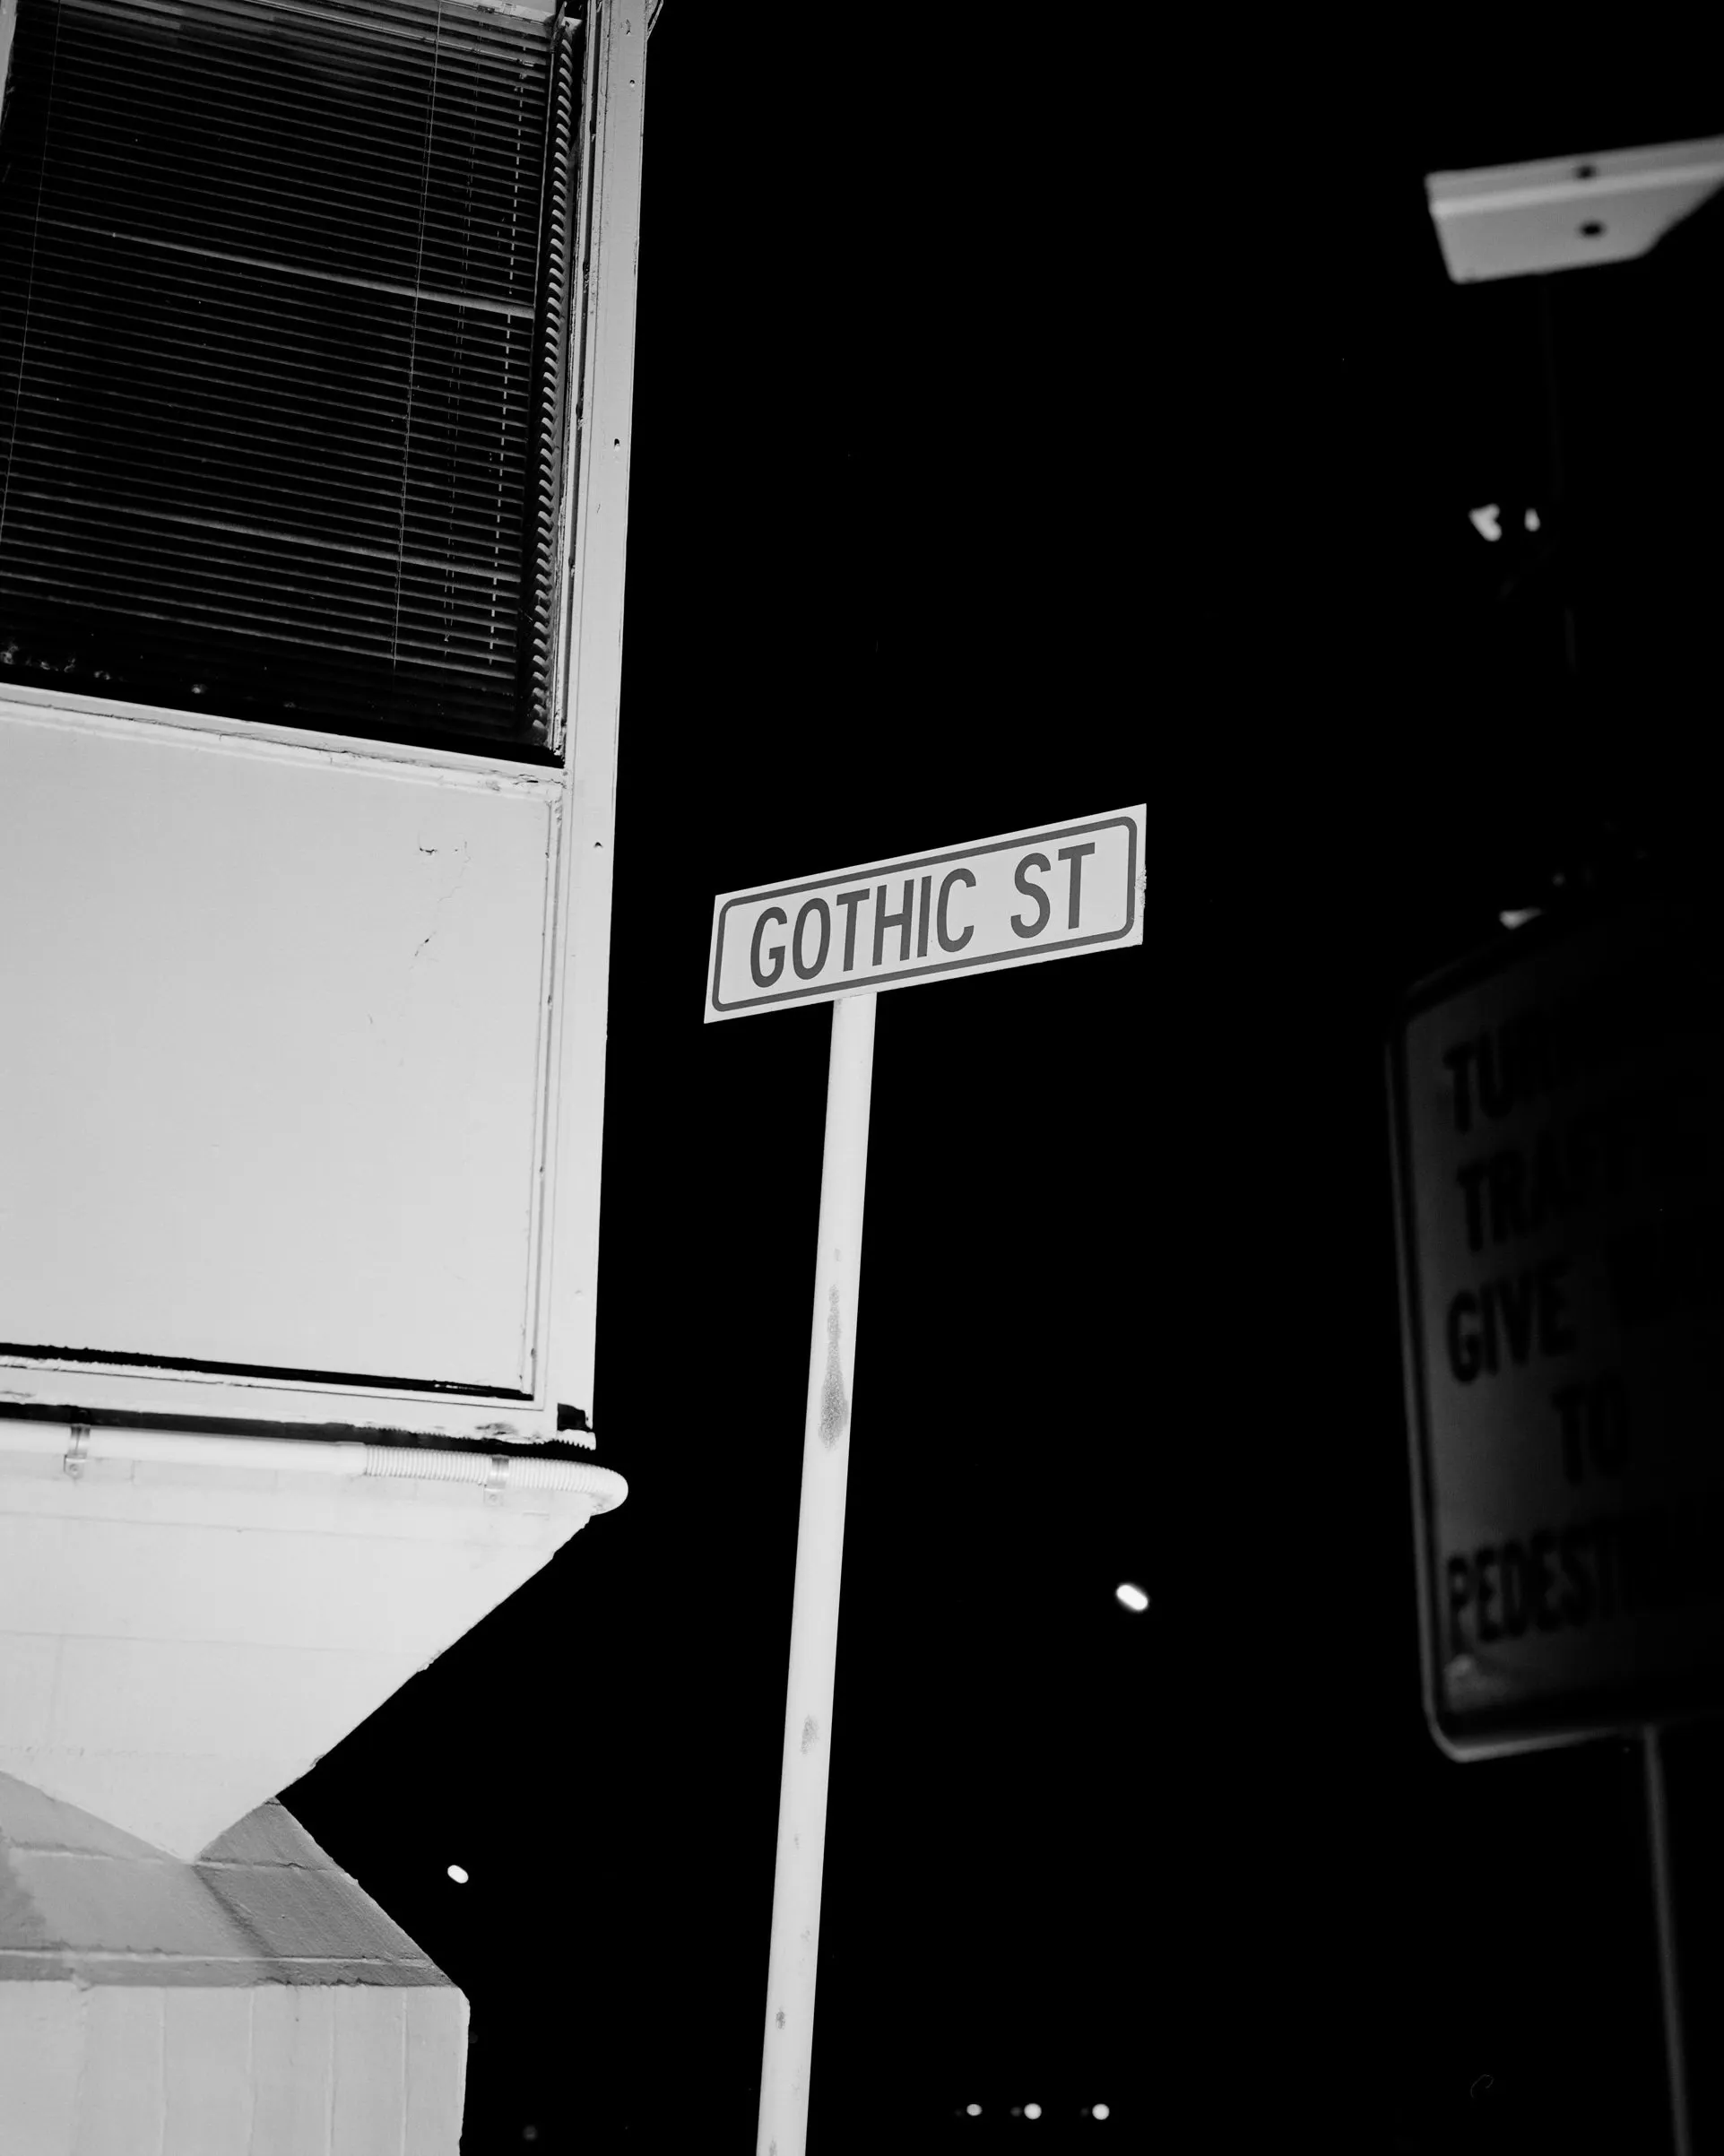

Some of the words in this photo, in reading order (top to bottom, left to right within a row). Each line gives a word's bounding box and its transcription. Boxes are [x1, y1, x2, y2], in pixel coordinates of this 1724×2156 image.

[750, 868, 977, 988] GOTHIC
[1009, 842, 1096, 939] ST
[1447, 1257, 1575, 1383] GIVE
[1552, 1374, 1631, 1485] TO
